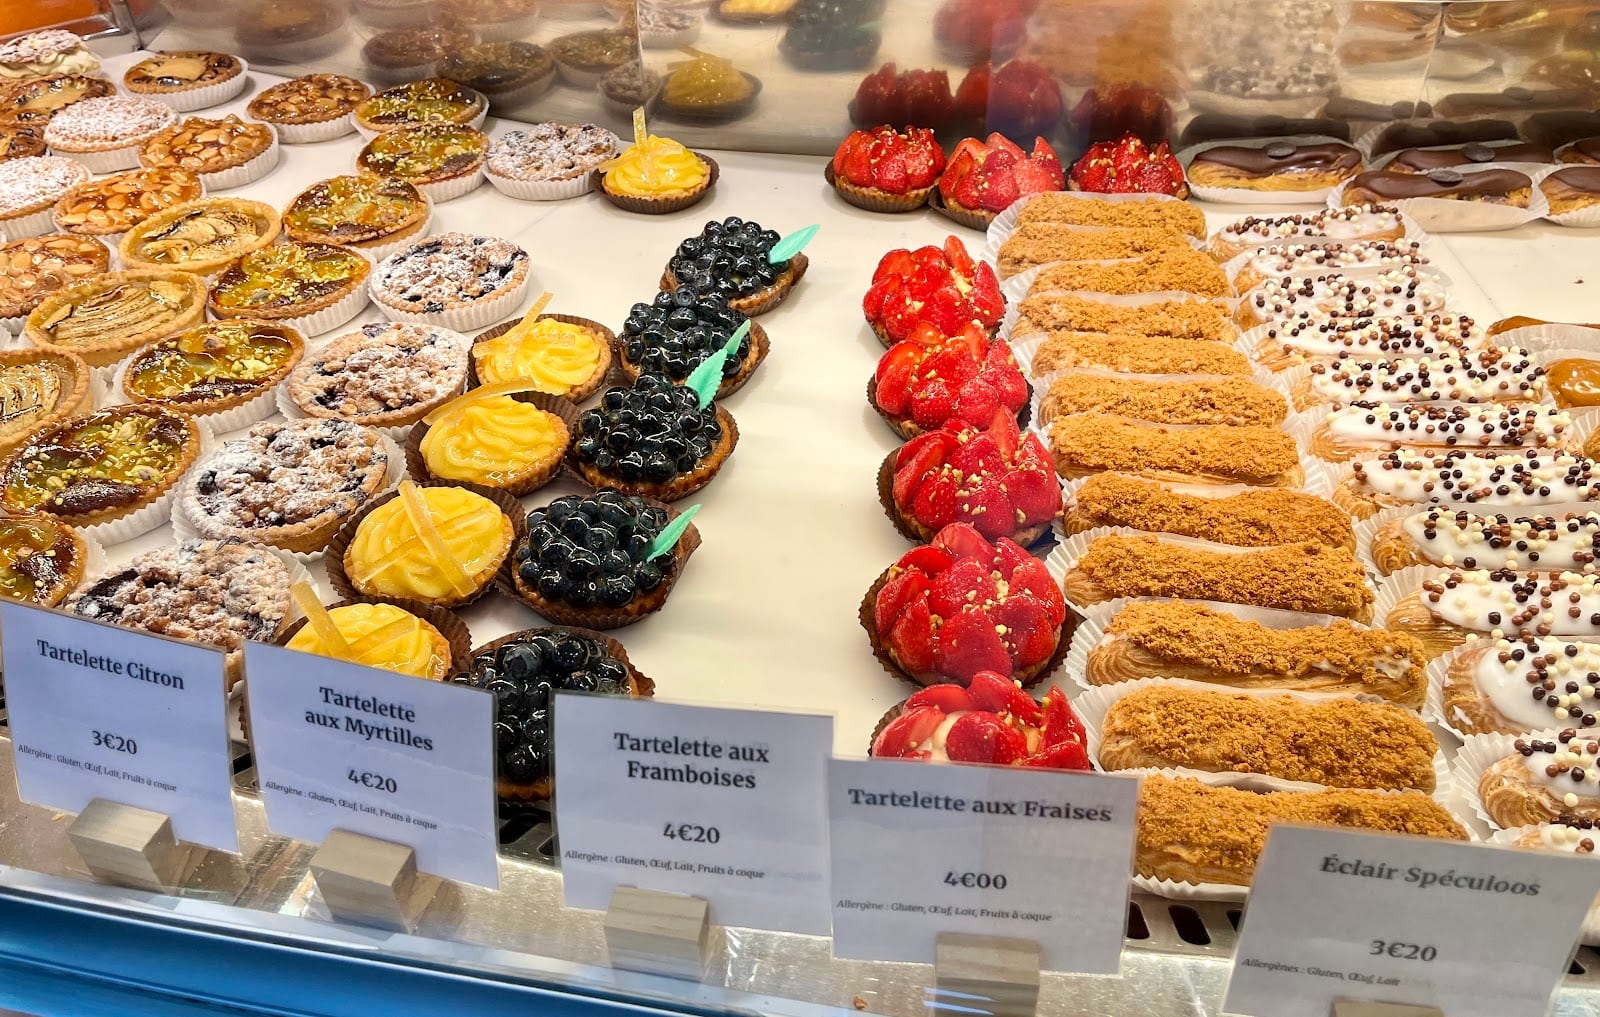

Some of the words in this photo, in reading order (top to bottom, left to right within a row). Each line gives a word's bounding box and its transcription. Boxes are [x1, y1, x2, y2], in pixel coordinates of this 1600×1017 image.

[37, 639, 123, 675] Tartelette
[126, 662, 185, 690] Citron
[319, 686, 416, 722] Tartelette
[92, 730, 138, 755] 3€20
[305, 710, 340, 729] aux
[345, 717, 433, 751] Myrtilles
[614, 732, 722, 758] Tartelette
[728, 745, 770, 763] aux
[18, 744, 52, 760] Allergène
[57, 755, 83, 770] Gluten,
[122, 772, 145, 784] Fruits
[153, 780, 177, 792] coque
[348, 769, 398, 793] 4€20
[627, 761, 756, 789] Framboises
[265, 781, 302, 797] Allergène
[308, 791, 337, 806] Gluten,
[359, 804, 378, 816] Lait,
[380, 809, 403, 822] Fruits
[405, 815, 411, 823] à
[413, 818, 438, 830] coque
[848, 789, 966, 812] Tartelette
[972, 799, 1017, 816] aux
[1024, 801, 1112, 822] Fraises
[663, 824, 720, 844] 4€20
[565, 851, 608, 863] Allergène
[615, 856, 648, 868] Gluten,
[674, 862, 696, 872] Lait,
[698, 864, 725, 875] Fruits
[727, 867, 734, 876] à
[736, 870, 765, 879] coque
[1320, 854, 1398, 880] Éclair
[1404, 866, 1541, 896] Spéculoos
[944, 872, 1007, 890] 4€00
[837, 900, 884, 912] Allergène
[891, 903, 927, 915] Gluten,
[980, 908, 1010, 919] Fruits
[1012, 910, 1019, 920] à
[1021, 912, 1052, 922] coque
[1369, 940, 1438, 962] 3€20
[1242, 958, 1299, 974] Allergènes
[1307, 966, 1344, 980] Gluten,
